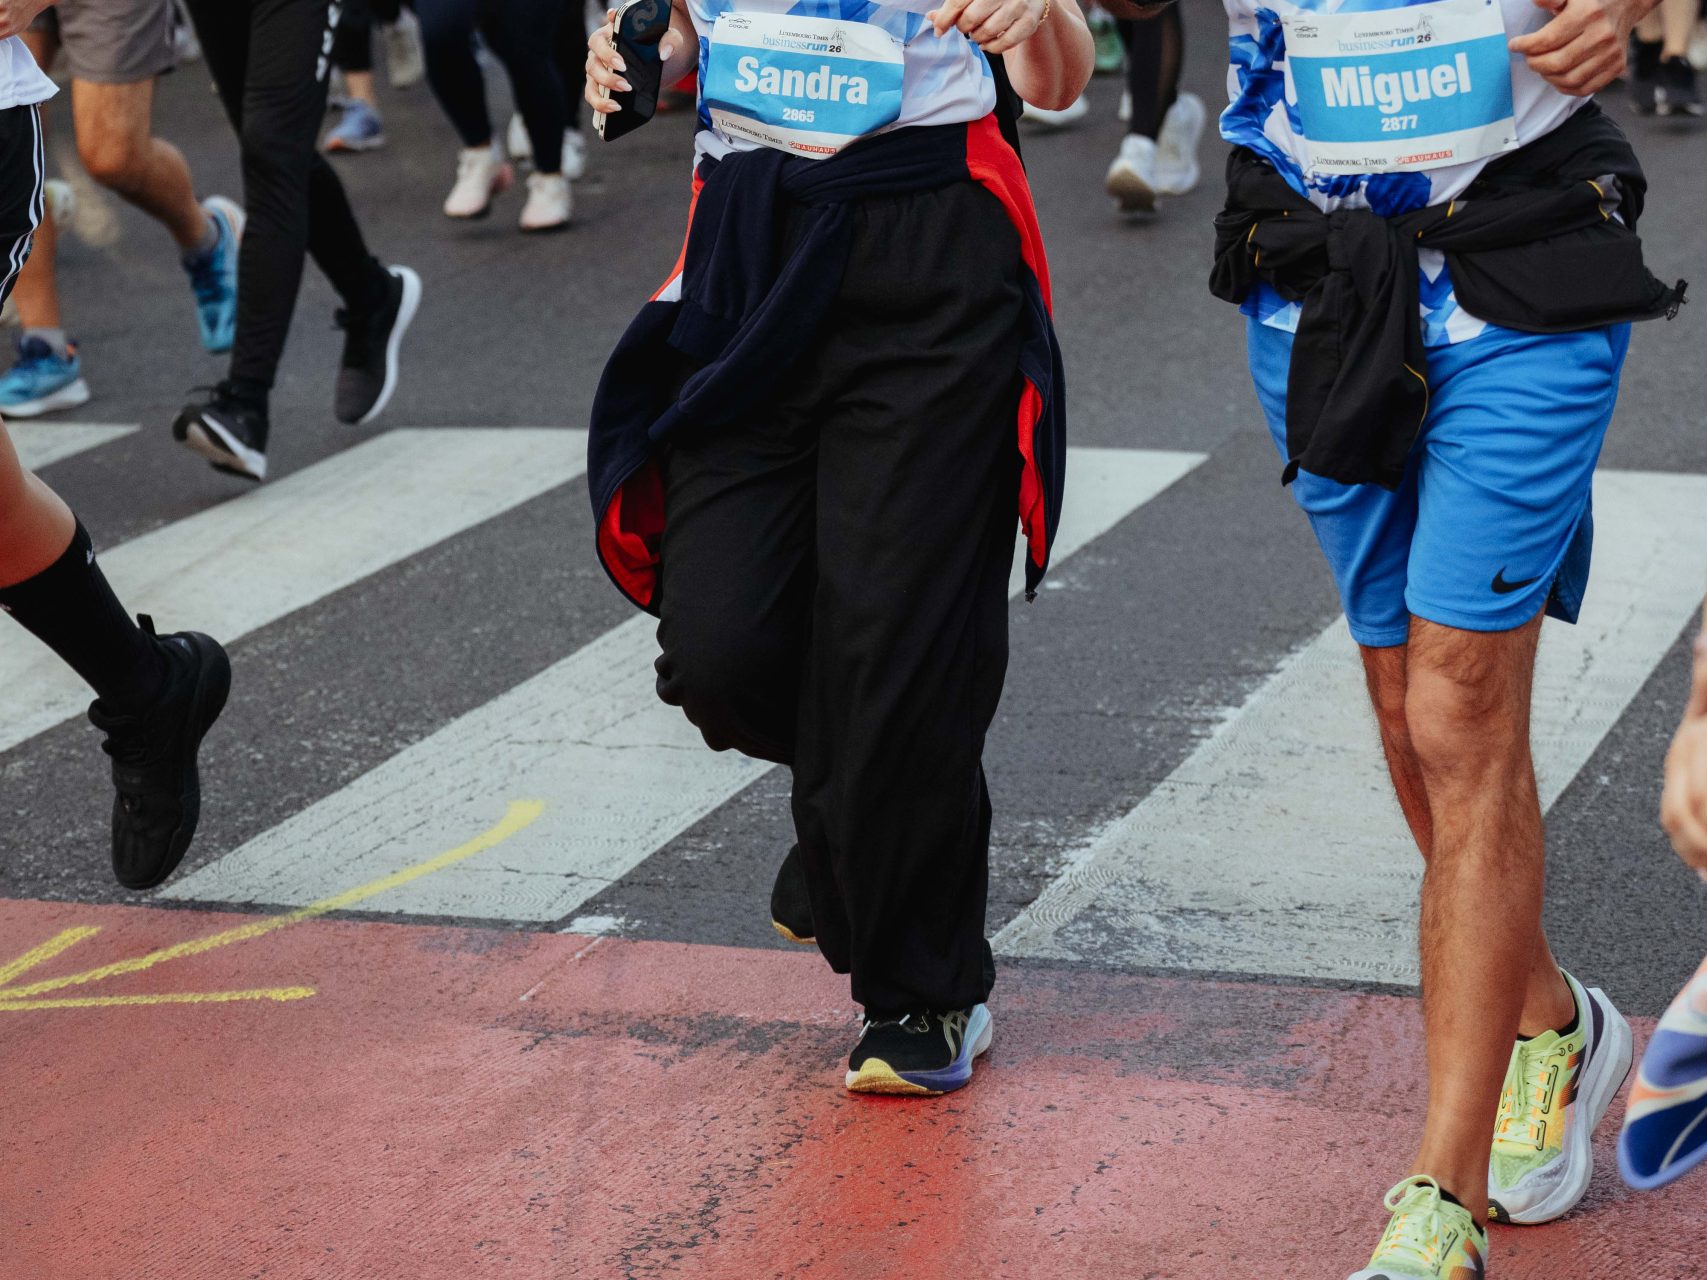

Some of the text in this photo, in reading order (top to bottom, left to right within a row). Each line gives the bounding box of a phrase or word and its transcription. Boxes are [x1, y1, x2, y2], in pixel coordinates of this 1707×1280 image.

[762, 34, 842, 53] businessrun 26
[1338, 33, 1431, 53] businessrun 26
[734, 55, 869, 105] Sandra
[1320, 51, 1472, 115] Miguel
[782, 107, 815, 123] 2865
[1380, 114, 1419, 133] 2877
[762, 133, 783, 145] TIMES
[1315, 155, 1388, 167] LUXEMBOURG TIMES
